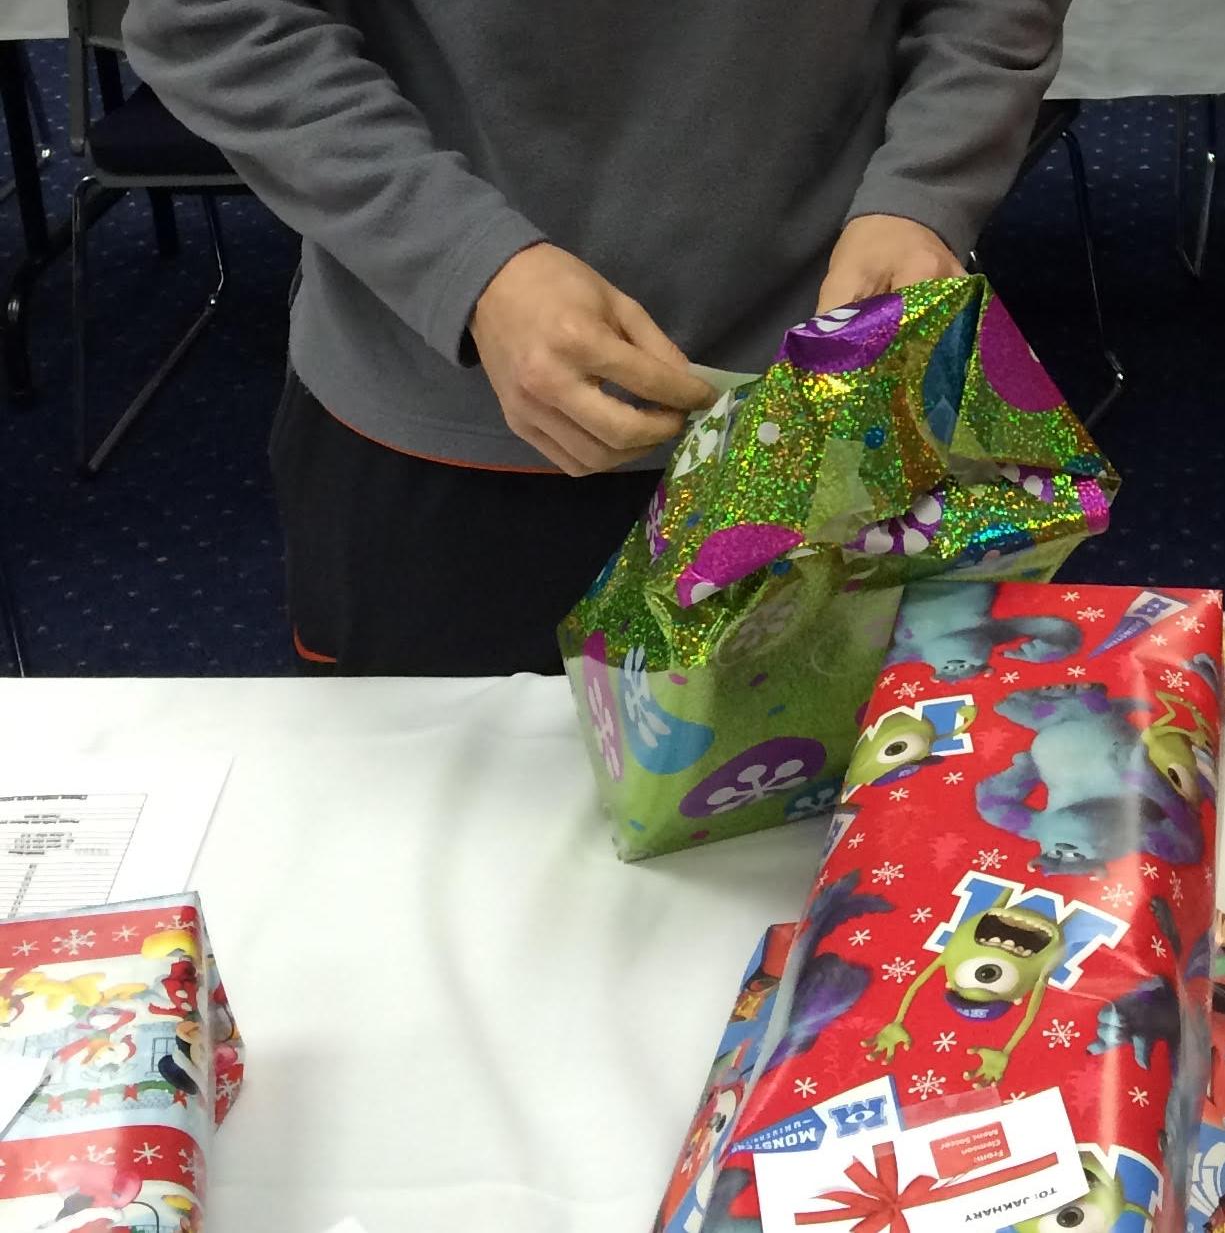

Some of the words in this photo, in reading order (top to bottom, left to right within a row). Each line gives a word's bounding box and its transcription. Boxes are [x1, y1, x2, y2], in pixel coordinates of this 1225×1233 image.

[961, 1139, 1001, 1154] Clemson
[974, 1149, 1004, 1162] From:
[1034, 1187, 1057, 1199] TO:
[965, 1197, 1030, 1222] JAKHARY
